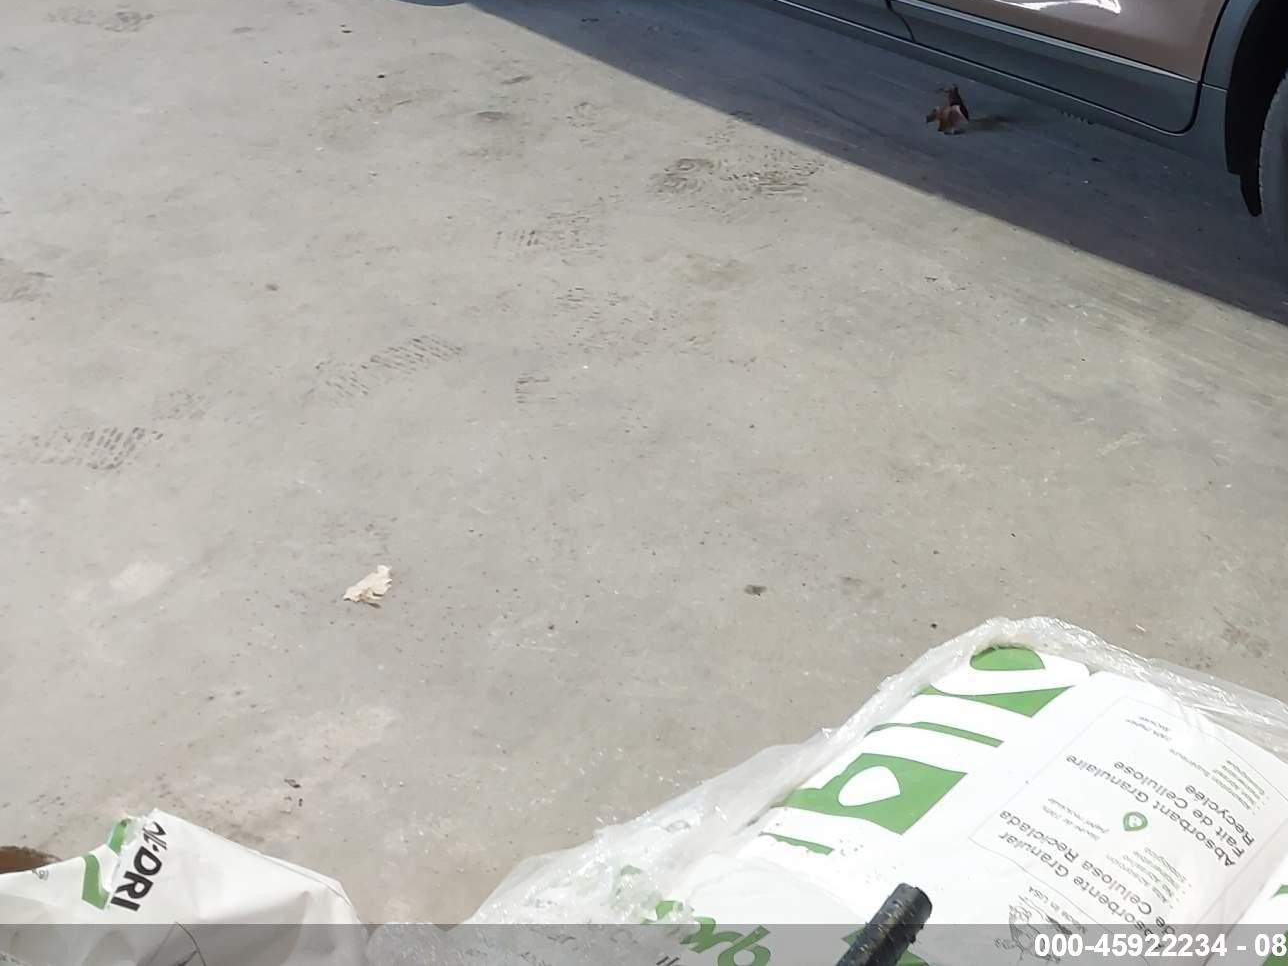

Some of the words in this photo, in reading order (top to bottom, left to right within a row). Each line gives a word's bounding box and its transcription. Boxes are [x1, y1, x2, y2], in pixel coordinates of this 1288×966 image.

[1066, 754, 1149, 803] Granulaire
[1114, 761, 1188, 809] Cellulose
[1000, 810, 1079, 863] Reciclada
[1153, 801, 1236, 866] Absorbant
[1185, 785, 1255, 846] Recyclée
[1192, 809, 1213, 826] de
[998, 832, 1069, 878] Granular
[1216, 826, 1245, 858] Fait
[1082, 860, 1152, 915] Celulosa
